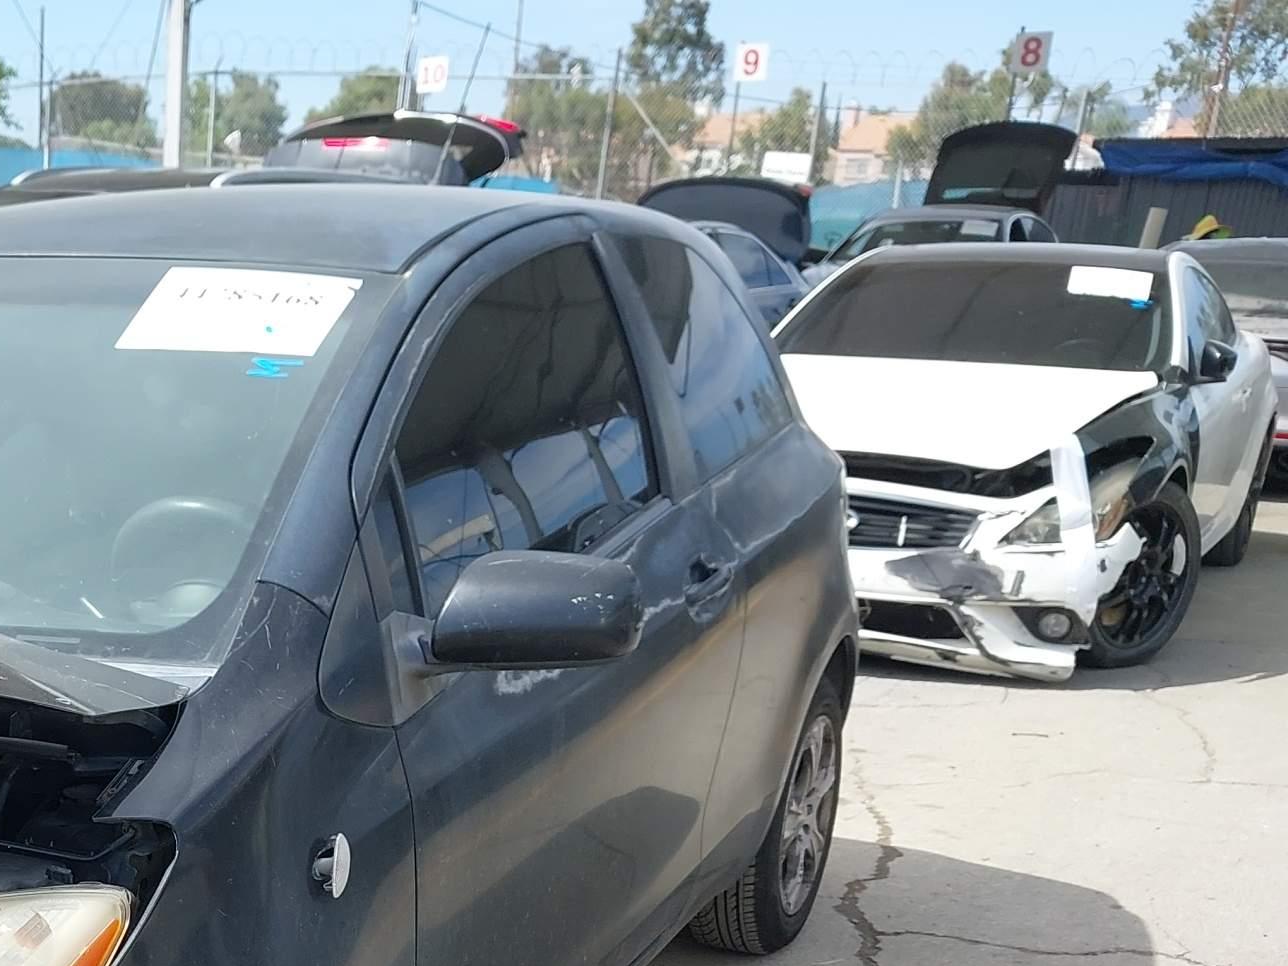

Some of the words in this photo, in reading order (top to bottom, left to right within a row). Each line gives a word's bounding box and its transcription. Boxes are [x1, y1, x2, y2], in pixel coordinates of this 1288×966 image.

[743, 48, 760, 76] 9
[1020, 36, 1043, 66] 8
[423, 63, 446, 84] 10
